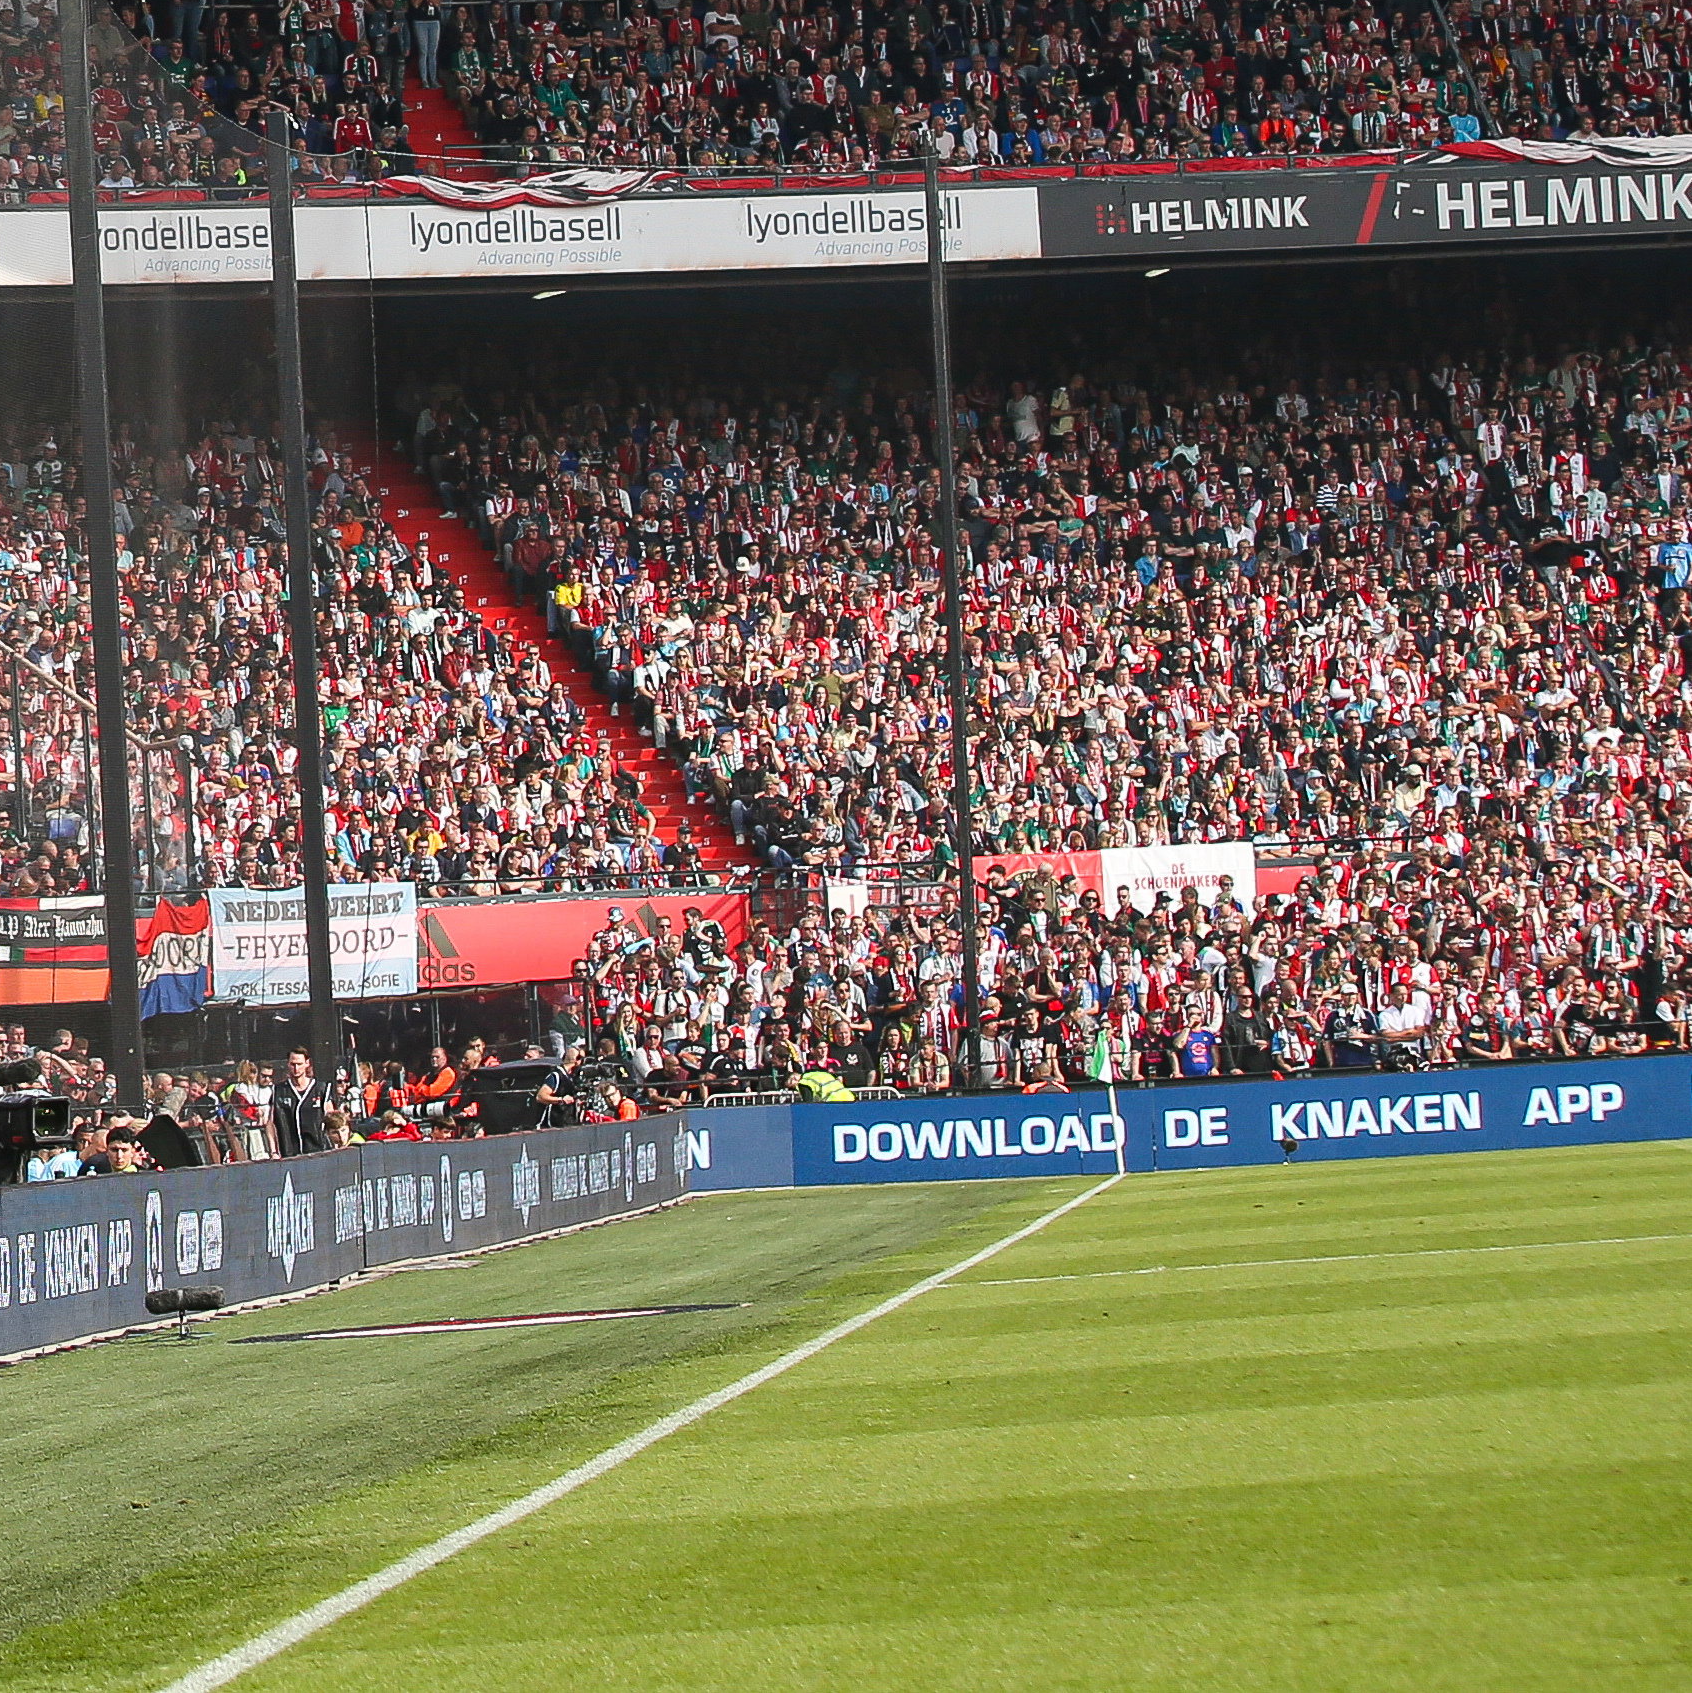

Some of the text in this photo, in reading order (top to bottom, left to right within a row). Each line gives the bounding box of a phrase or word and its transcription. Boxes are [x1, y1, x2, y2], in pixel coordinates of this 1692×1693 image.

[746, 194, 962, 243] lyondellbasll
[1131, 195, 1310, 235] HELMINK
[1435, 173, 1692, 232] HELMINK
[410, 206, 622, 252] lyondellbasell
[814, 239, 893, 257] Advancing
[144, 252, 273, 274] Advancing Possib
[476, 246, 623, 269] Advancing Possible
[1170, 863, 1187, 876] DE
[22, 914, 51, 939] Alex
[831, 1081, 1625, 1166] DOWNLOAD DE KNAKEN APP
[17, 1230, 37, 1306] DE
[44, 1223, 99, 1299] KNAKEN
[106, 1218, 134, 1286] APP
